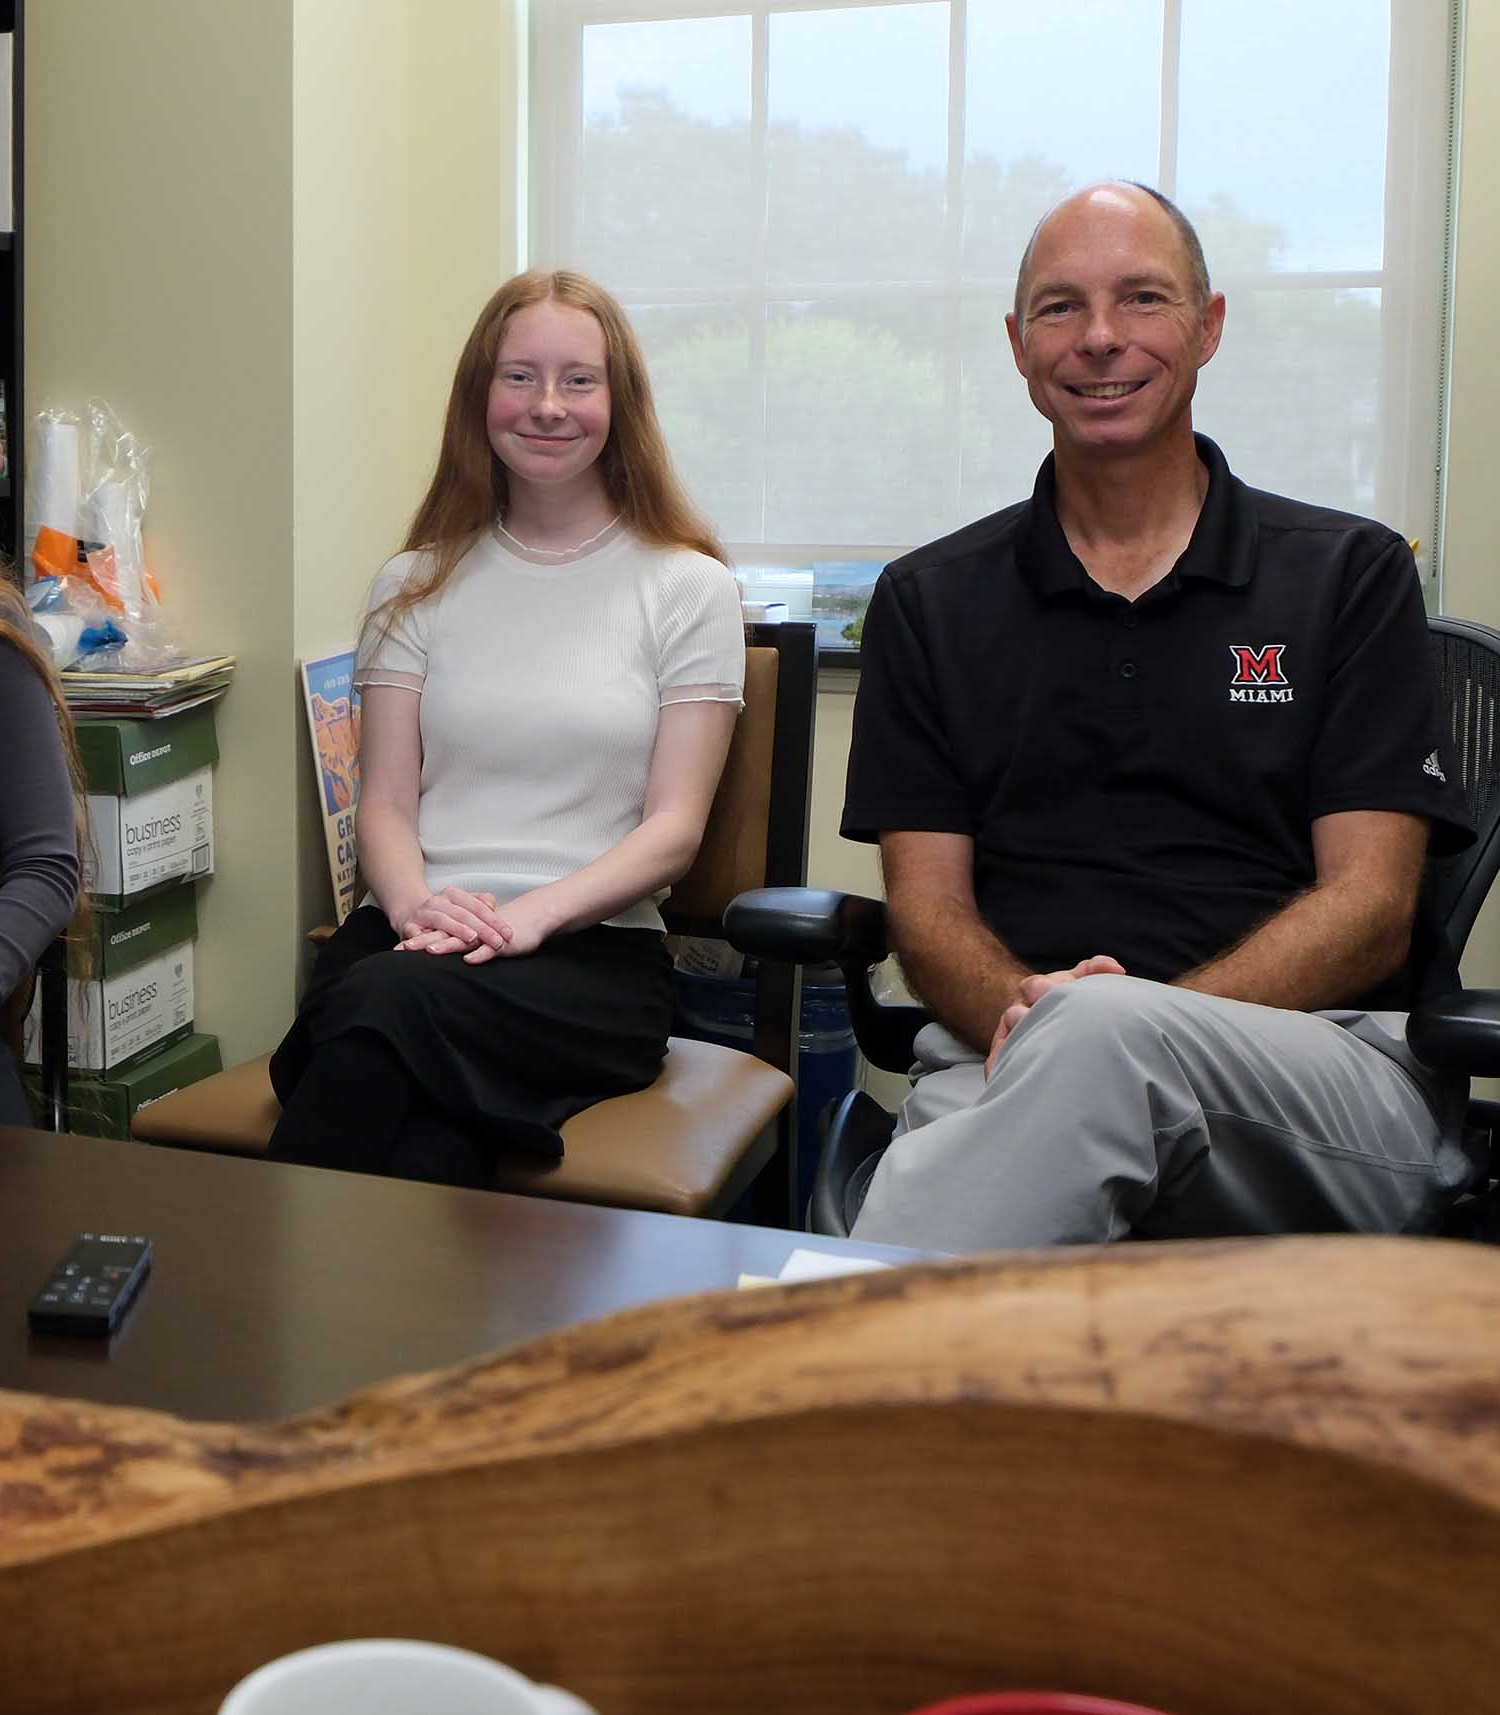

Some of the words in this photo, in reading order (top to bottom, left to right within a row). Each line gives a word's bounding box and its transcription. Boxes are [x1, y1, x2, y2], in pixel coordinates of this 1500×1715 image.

[1229, 644, 1289, 685] M
[1229, 688, 1294, 703] MIAMI
[130, 751, 152, 766] Office
[152, 744, 172, 758] DEPOT
[125, 814, 181, 845] business
[110, 930, 132, 945] Office
[108, 981, 157, 1020] business
